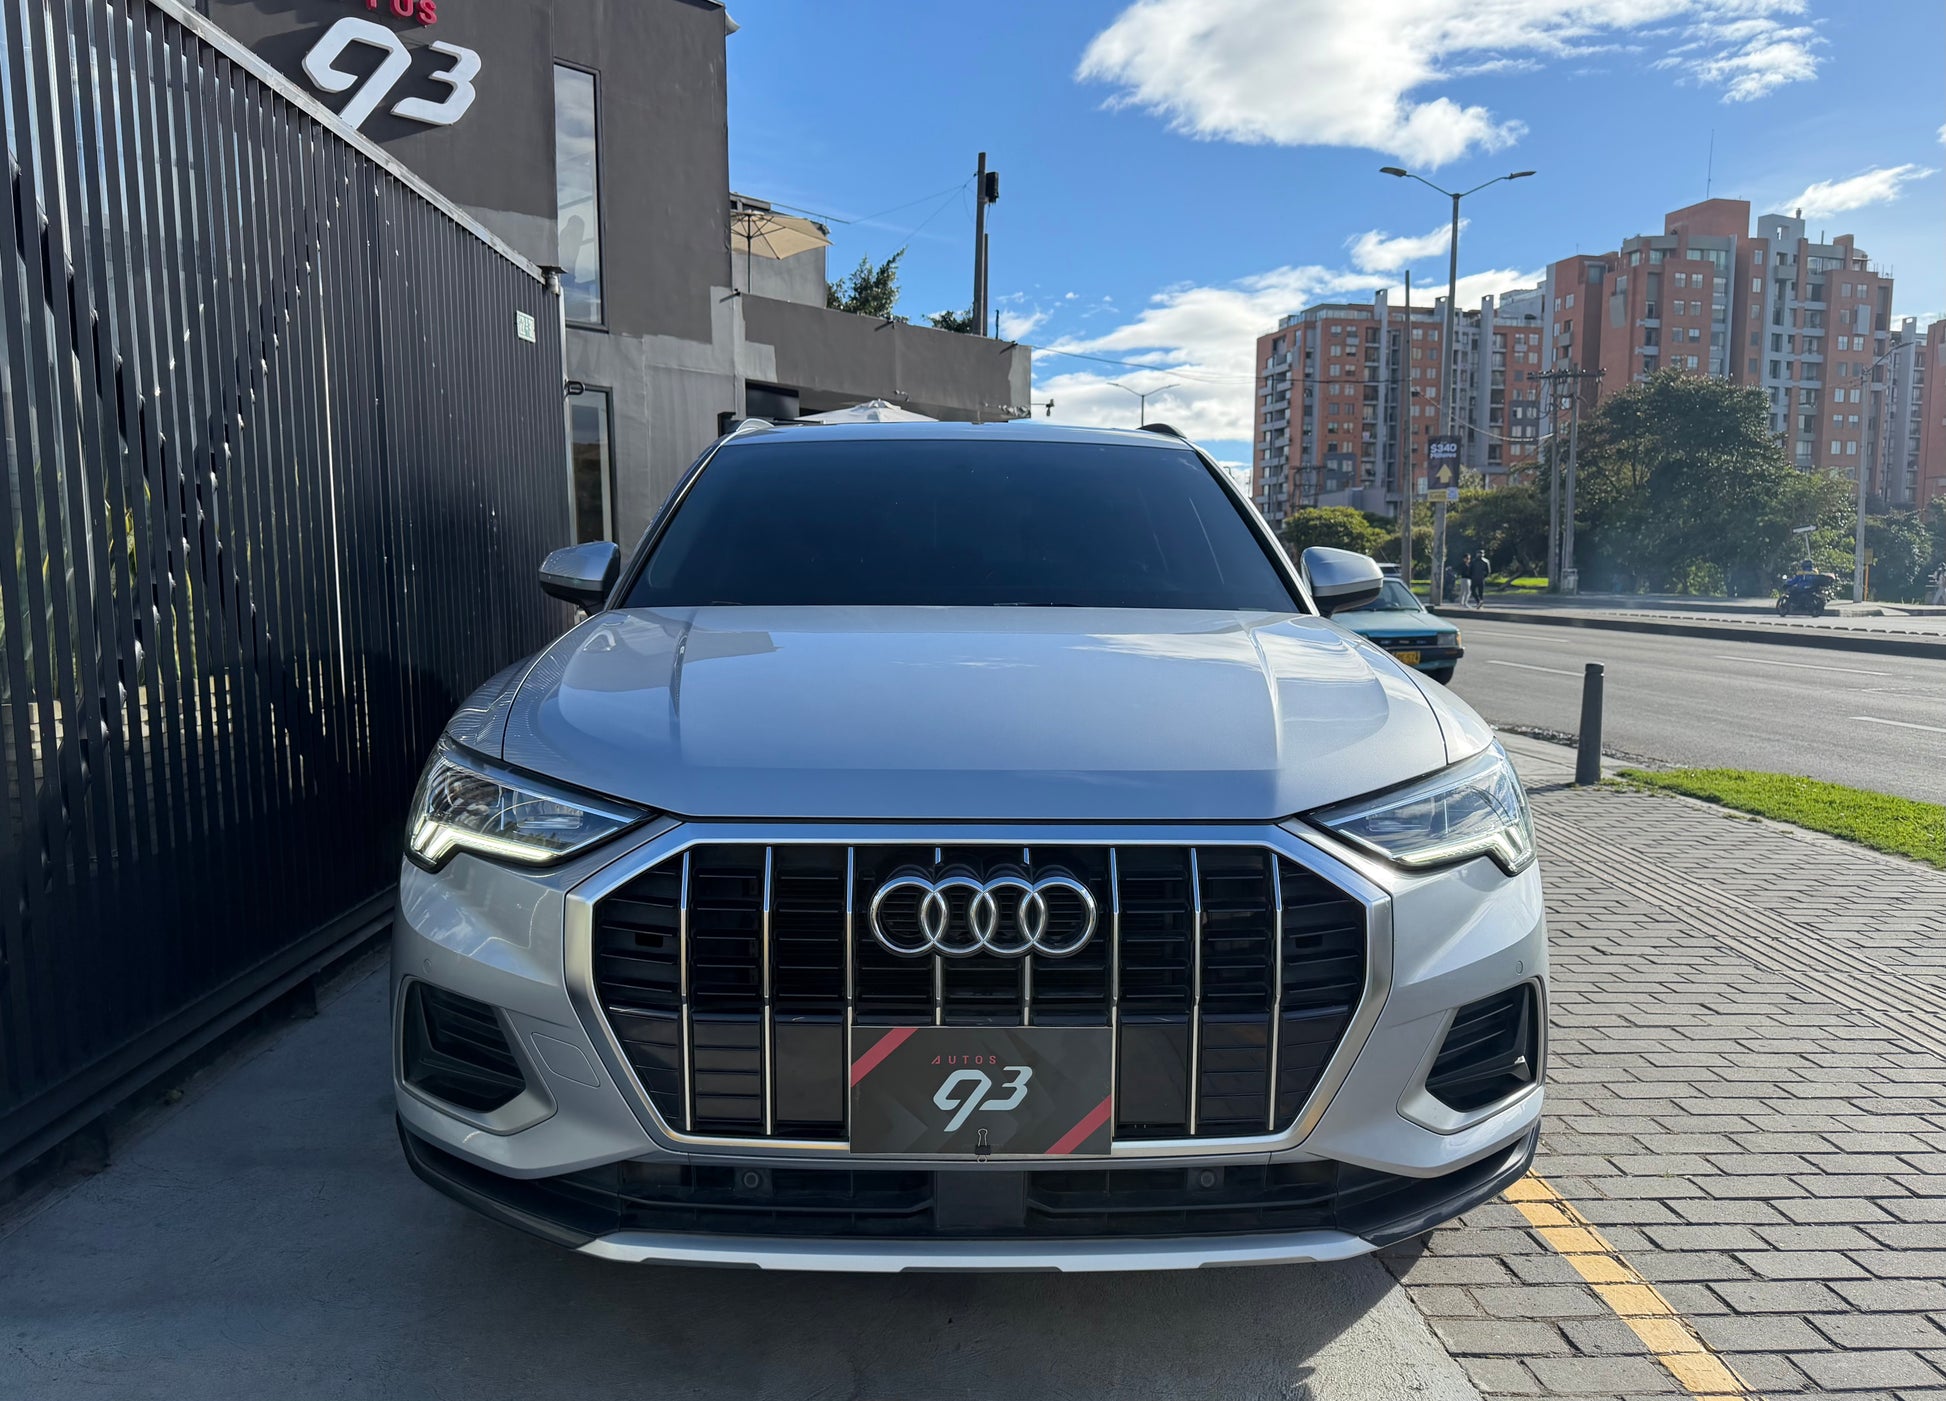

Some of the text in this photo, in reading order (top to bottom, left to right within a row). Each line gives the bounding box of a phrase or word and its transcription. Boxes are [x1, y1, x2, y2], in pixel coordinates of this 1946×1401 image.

[302, 16, 482, 130] 93
[1430, 443, 1457, 453] $340
[931, 1055, 997, 1065] AUTOS
[933, 1066, 1033, 1132] 93
